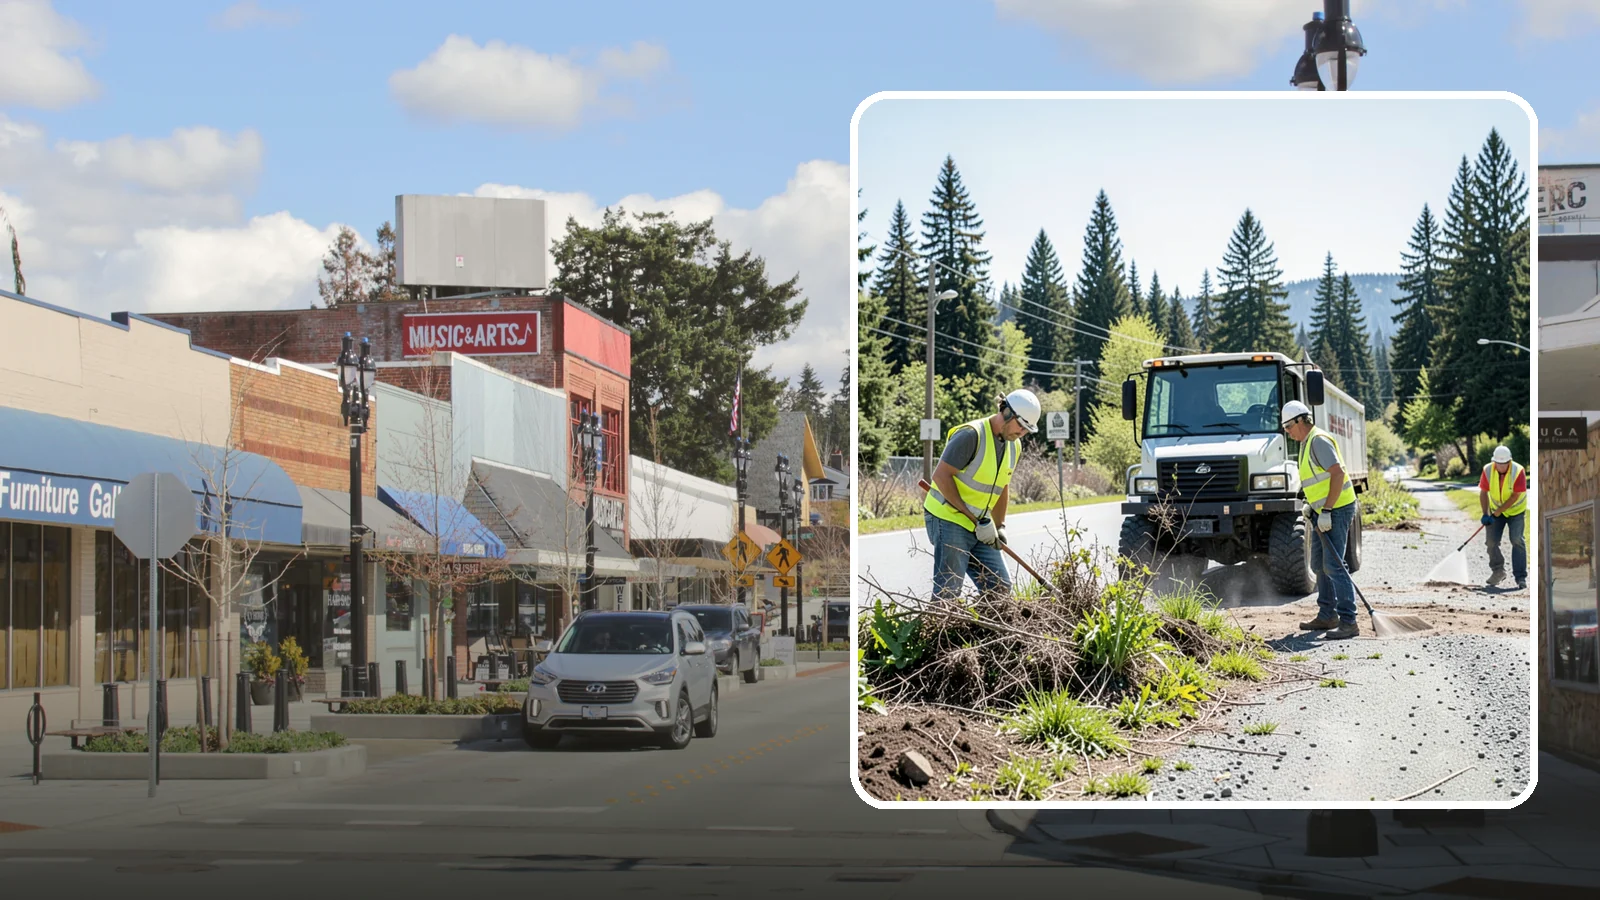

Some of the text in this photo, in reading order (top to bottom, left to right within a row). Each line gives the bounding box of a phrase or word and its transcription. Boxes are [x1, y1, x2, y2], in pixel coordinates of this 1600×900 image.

[408, 323, 519, 349] MUSIC&ARTS
[1540, 427, 1578, 437] UGA
[0, 471, 122, 519] Furniture Gal
